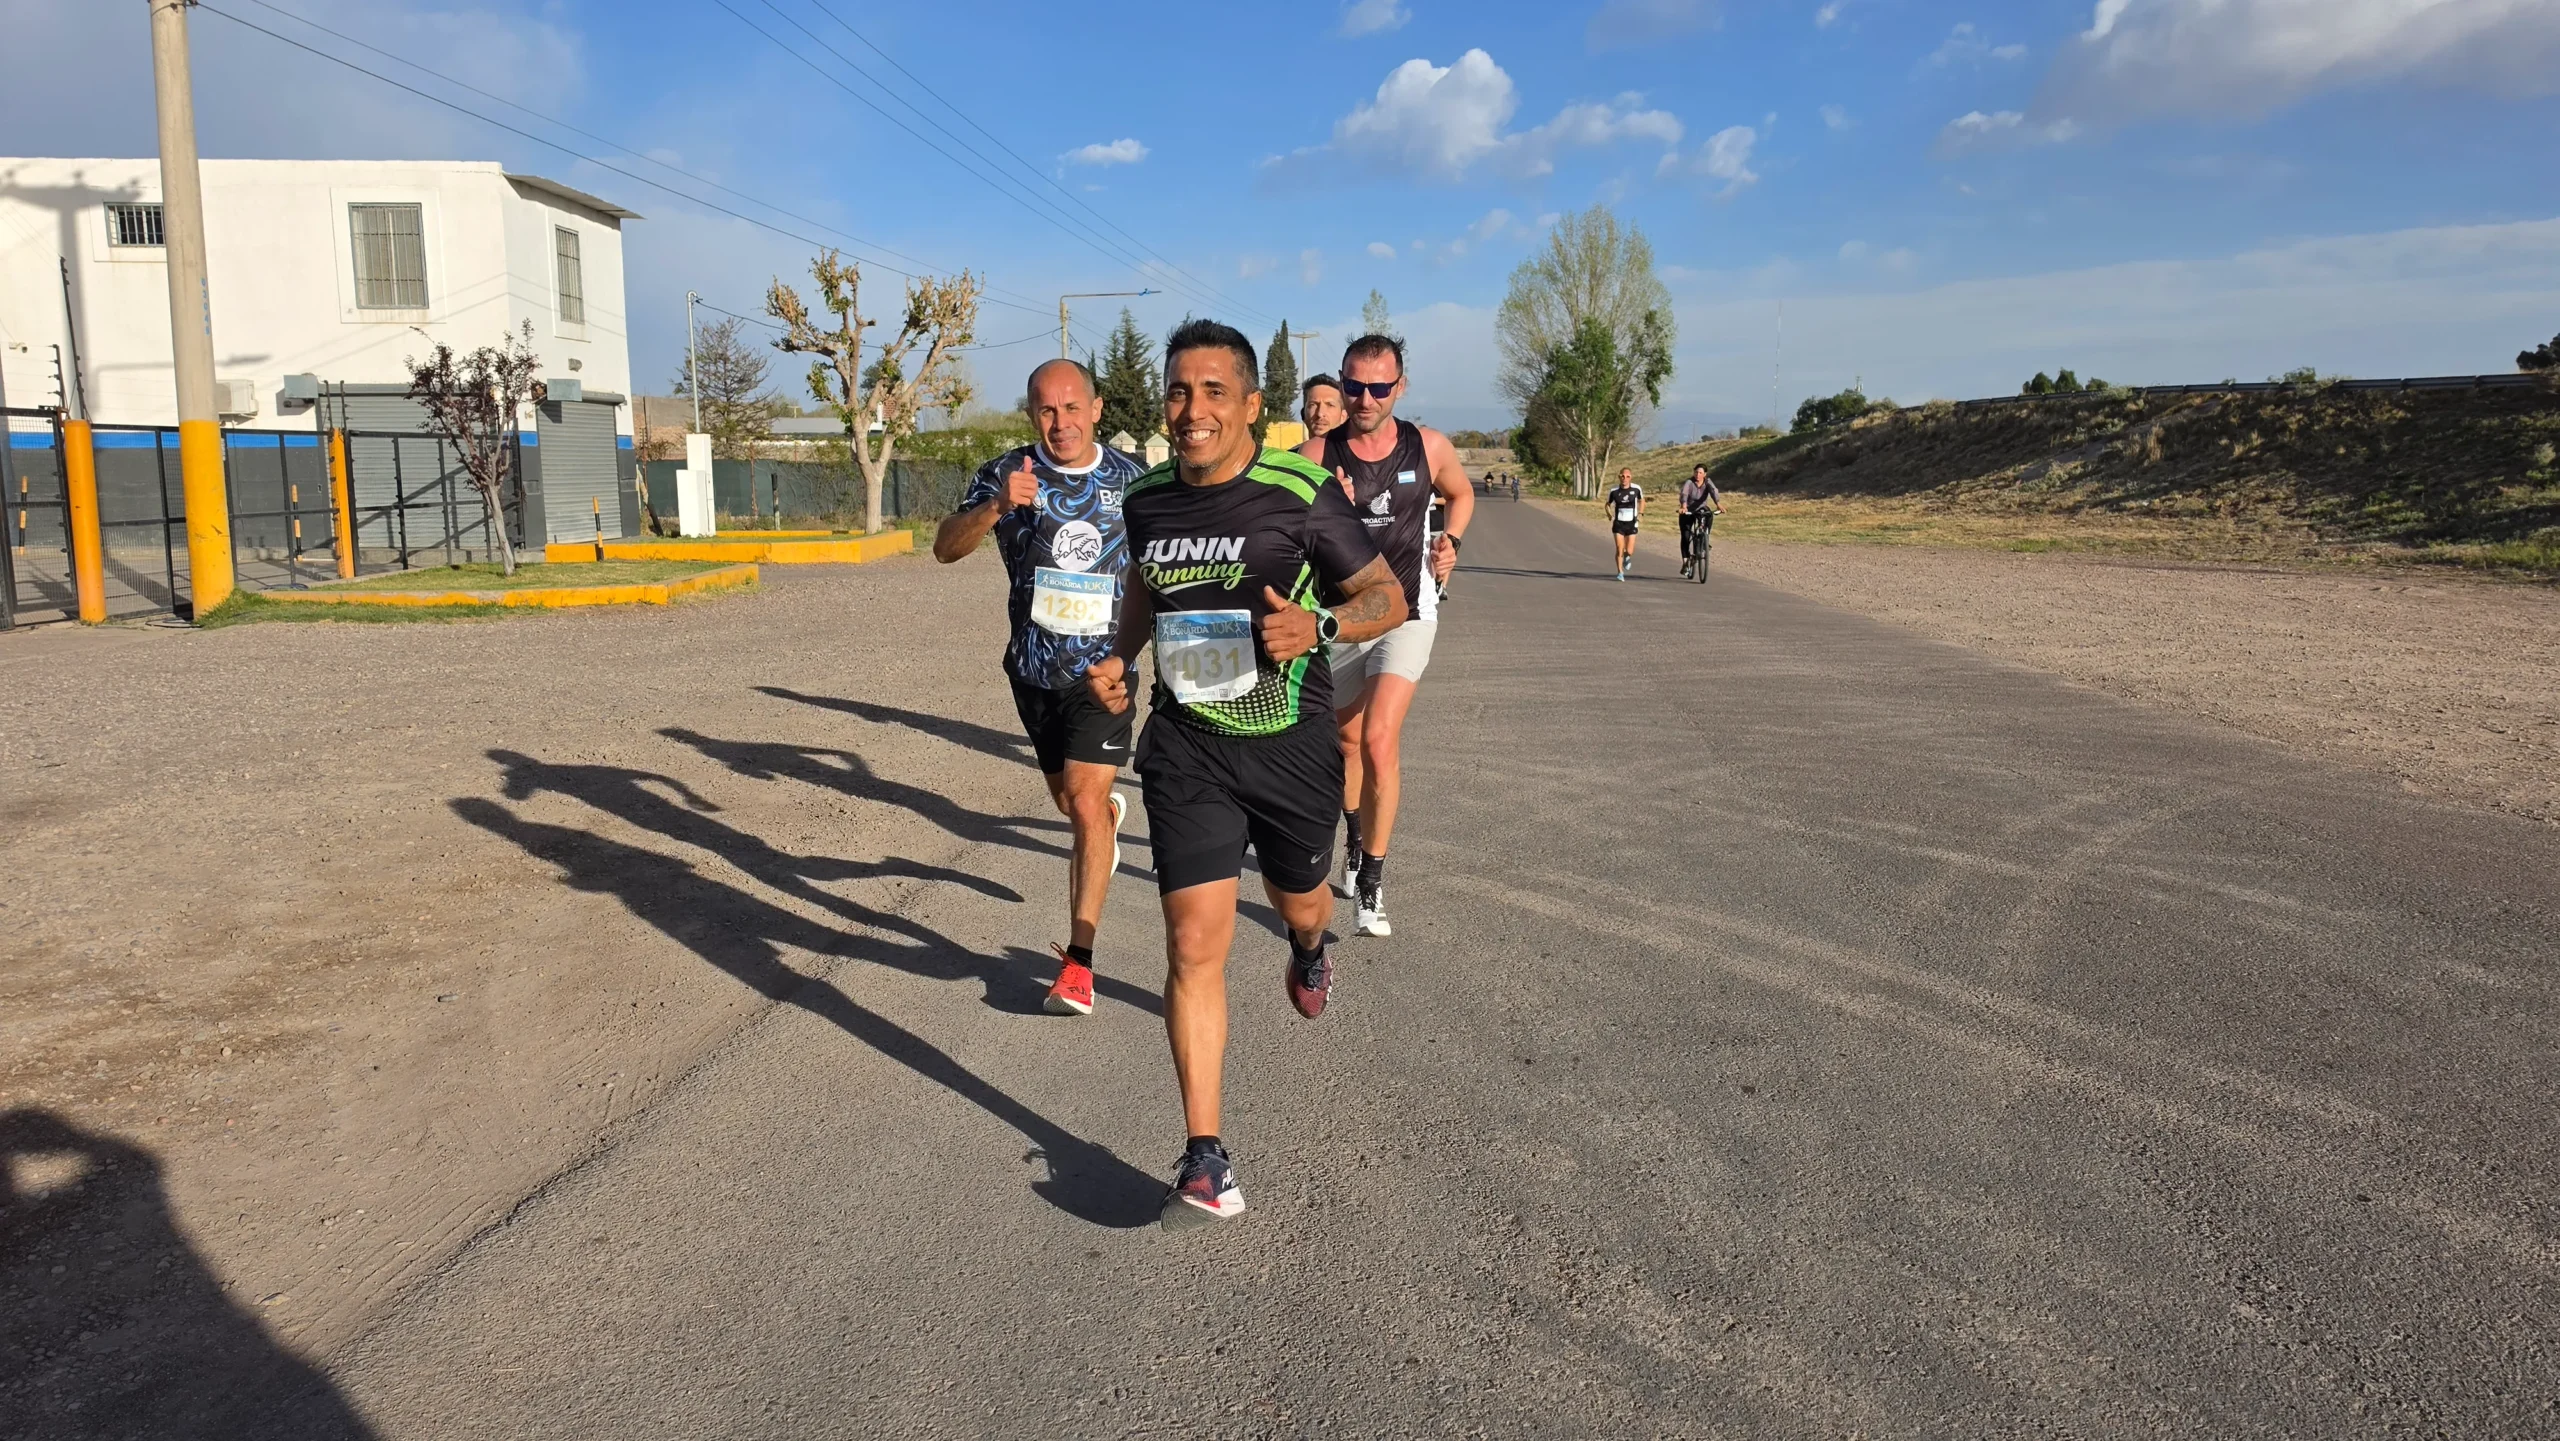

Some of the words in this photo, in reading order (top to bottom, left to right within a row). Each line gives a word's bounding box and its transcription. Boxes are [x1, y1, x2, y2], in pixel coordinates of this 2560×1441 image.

[1139, 537, 1246, 562] JUNIN
[1049, 579, 1082, 589] BONARDA
[1083, 580, 1102, 591] 10K
[1140, 559, 1248, 594] Running
[1170, 626, 1210, 636] BONARDA
[1209, 620, 1236, 635] 10K
[1166, 646, 1240, 681] 1031
